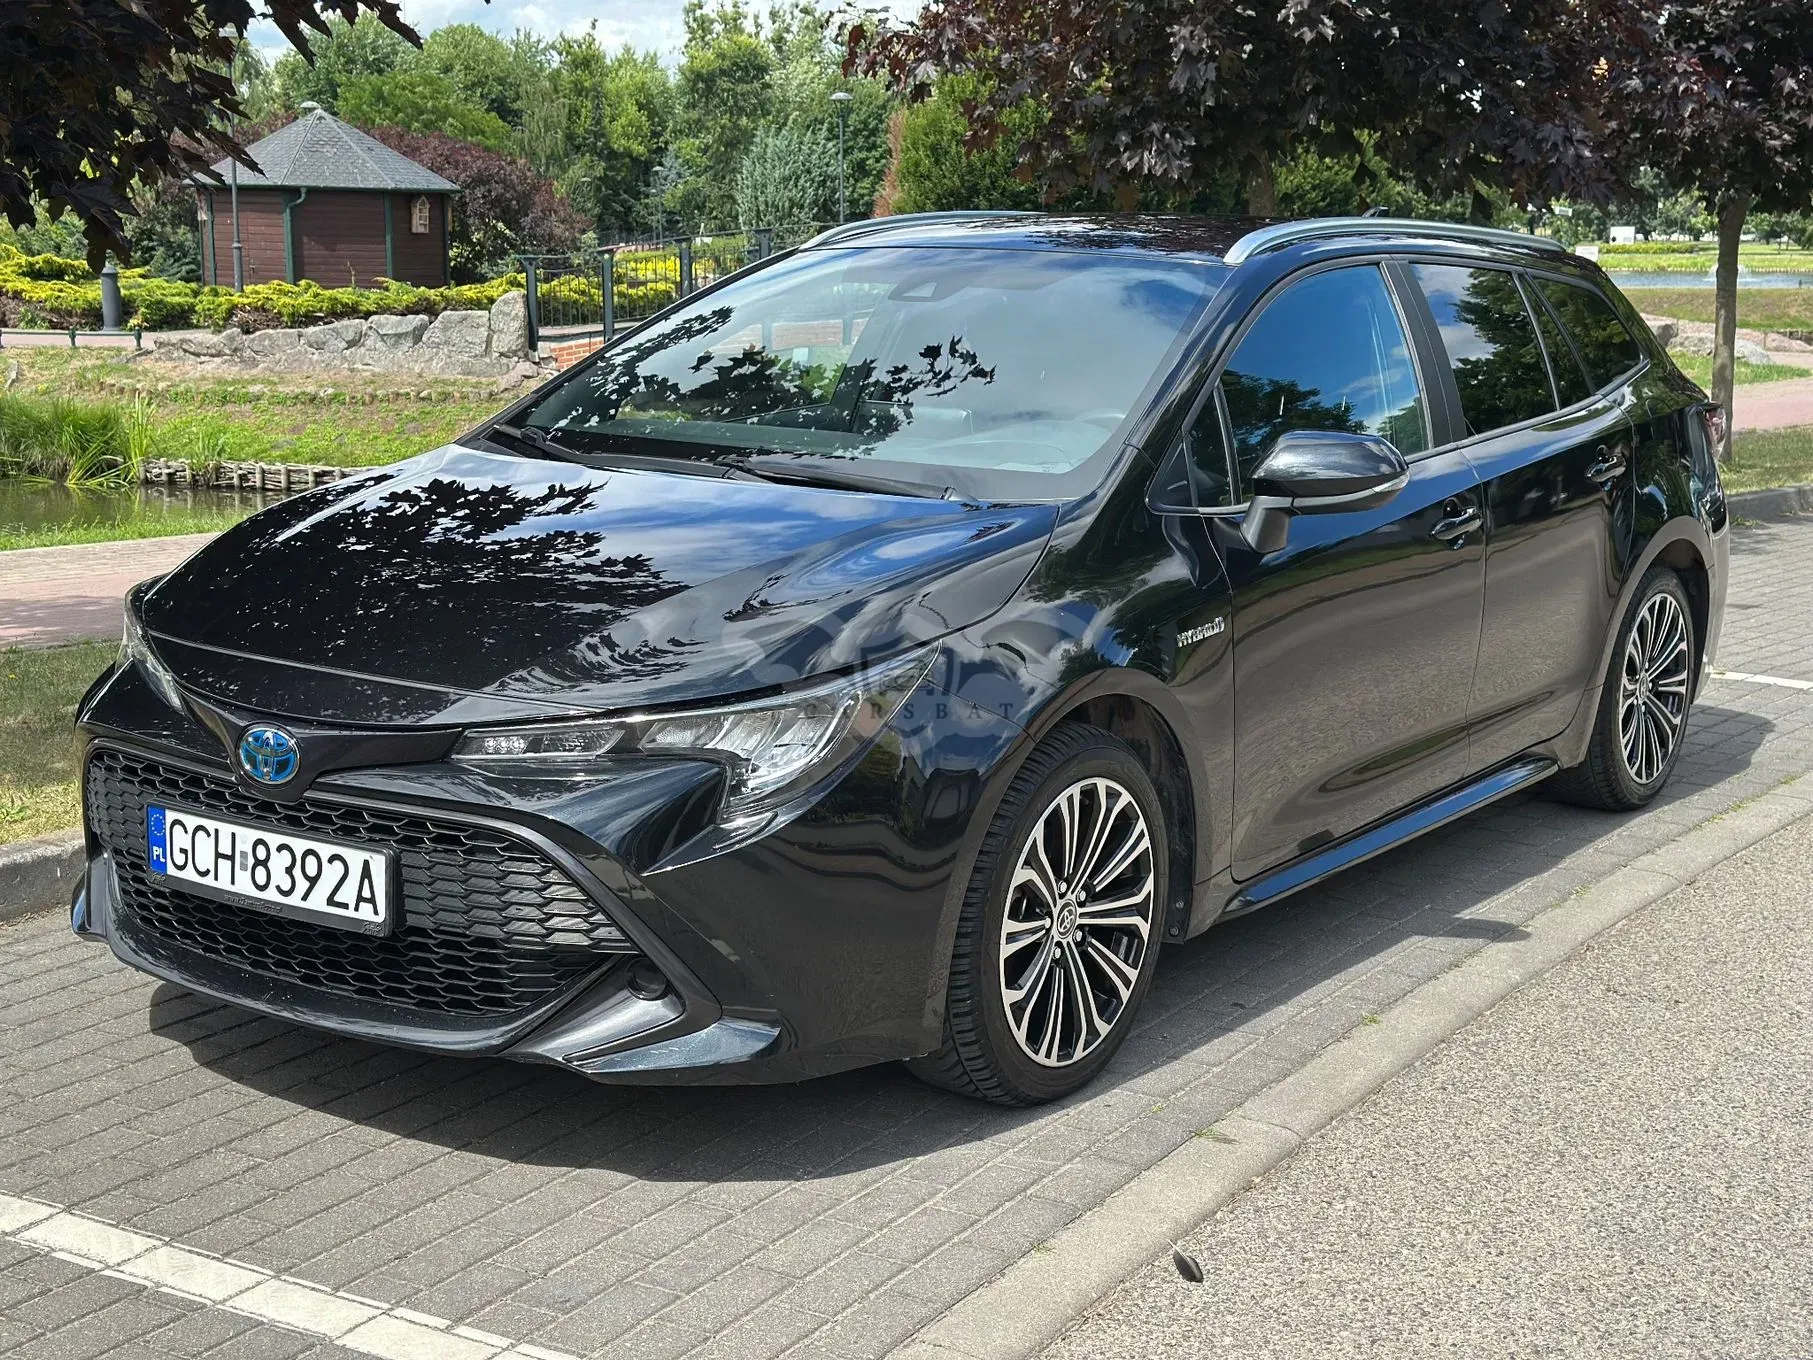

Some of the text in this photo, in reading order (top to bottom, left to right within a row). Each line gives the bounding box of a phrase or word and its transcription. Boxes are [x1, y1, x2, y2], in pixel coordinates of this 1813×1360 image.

[1176, 616, 1225, 648] HYBRID
[152, 845, 166, 863] PL
[169, 818, 380, 916] GCH 8392A
